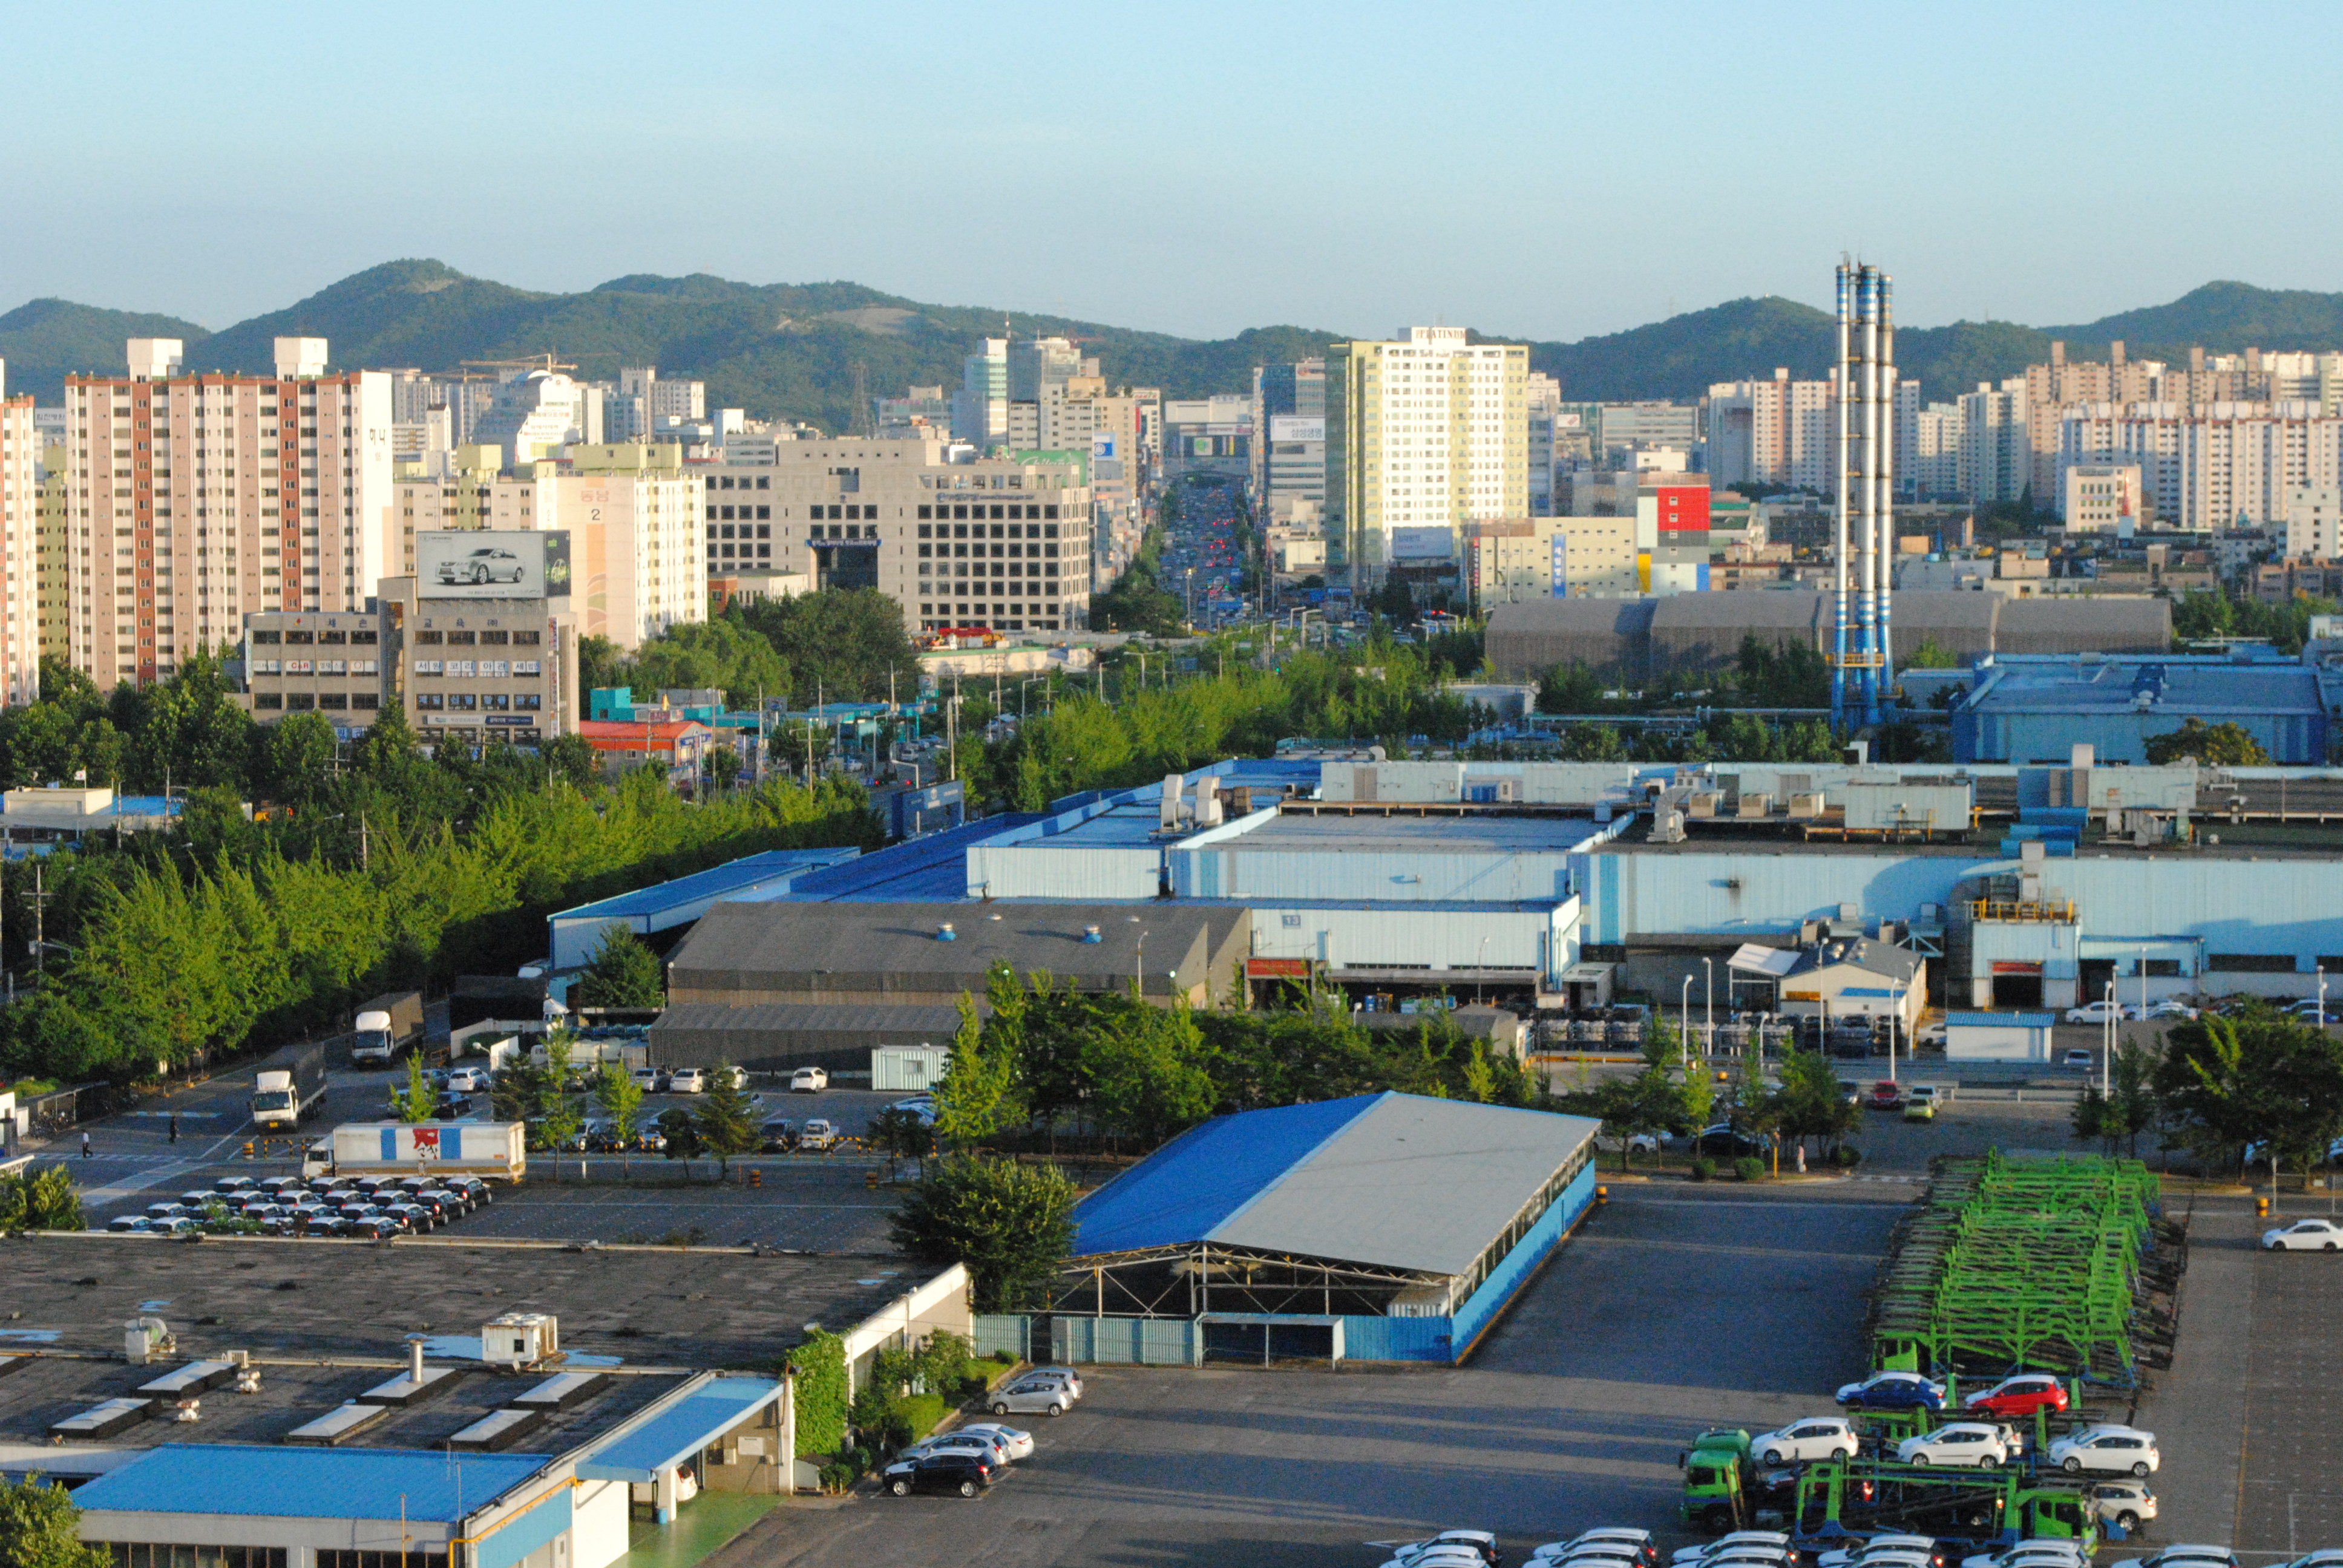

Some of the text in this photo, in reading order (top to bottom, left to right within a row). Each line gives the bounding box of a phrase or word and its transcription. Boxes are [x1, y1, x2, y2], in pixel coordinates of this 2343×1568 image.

[1291, 428, 1322, 439] 삼성생명
[591, 508, 601, 521] 2
[1285, 916, 1299, 925] 13
